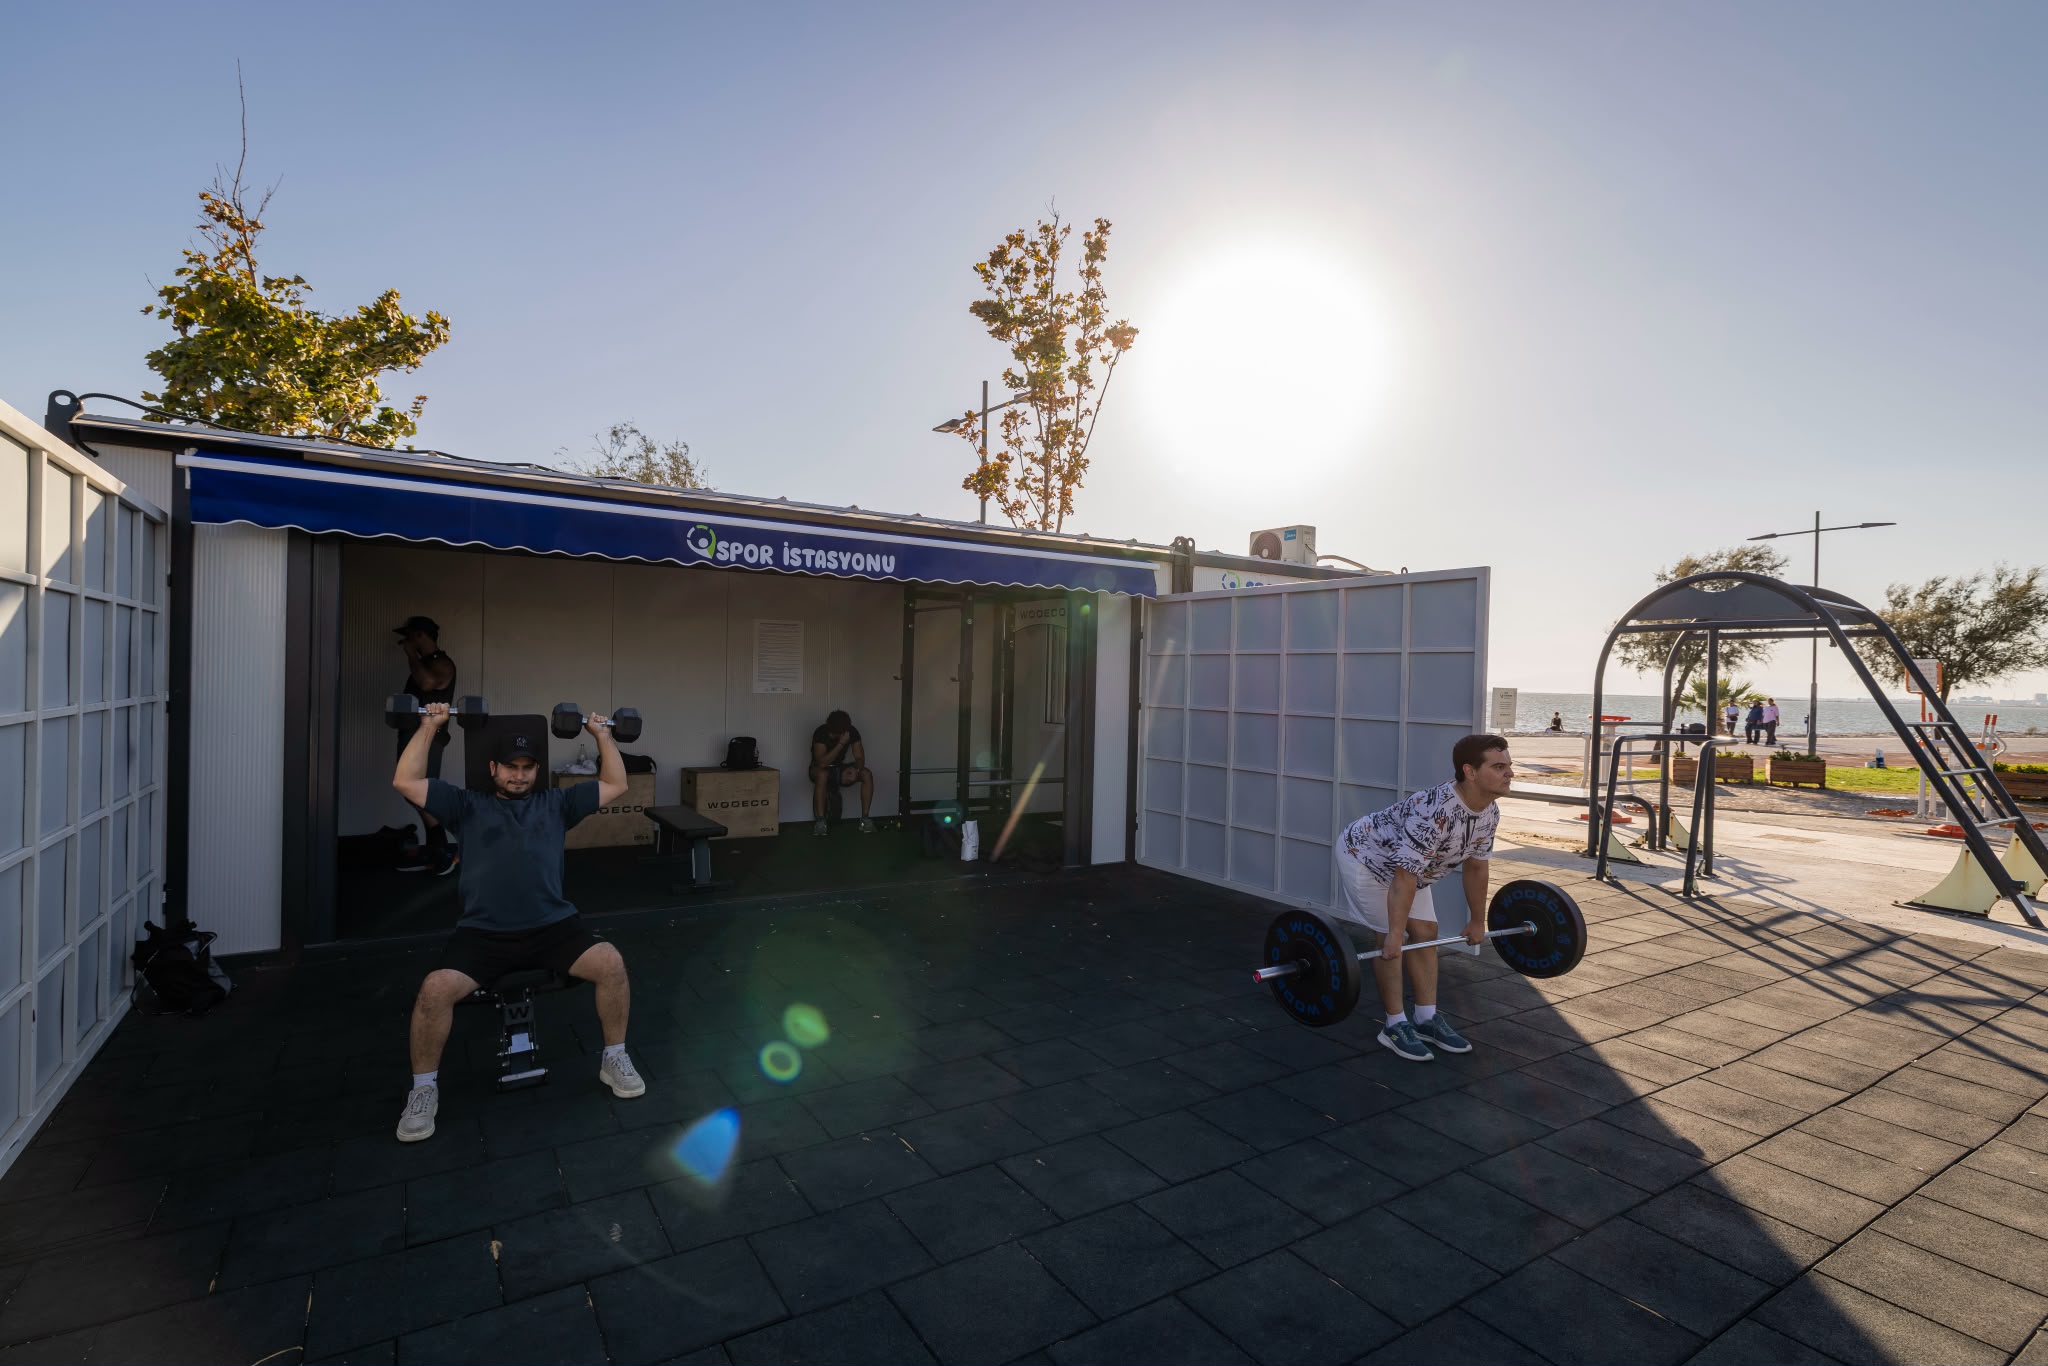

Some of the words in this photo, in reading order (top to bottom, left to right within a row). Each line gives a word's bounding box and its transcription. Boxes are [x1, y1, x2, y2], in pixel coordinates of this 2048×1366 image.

[716, 540, 774, 565] SPOR
[783, 541, 896, 573] İSTASYONU
[1020, 607, 1067, 619] WODECO
[591, 805, 643, 815] DECO
[707, 799, 769, 809] WODECO
[1502, 888, 1567, 925] WODECO
[1289, 919, 1342, 992] WODECO
